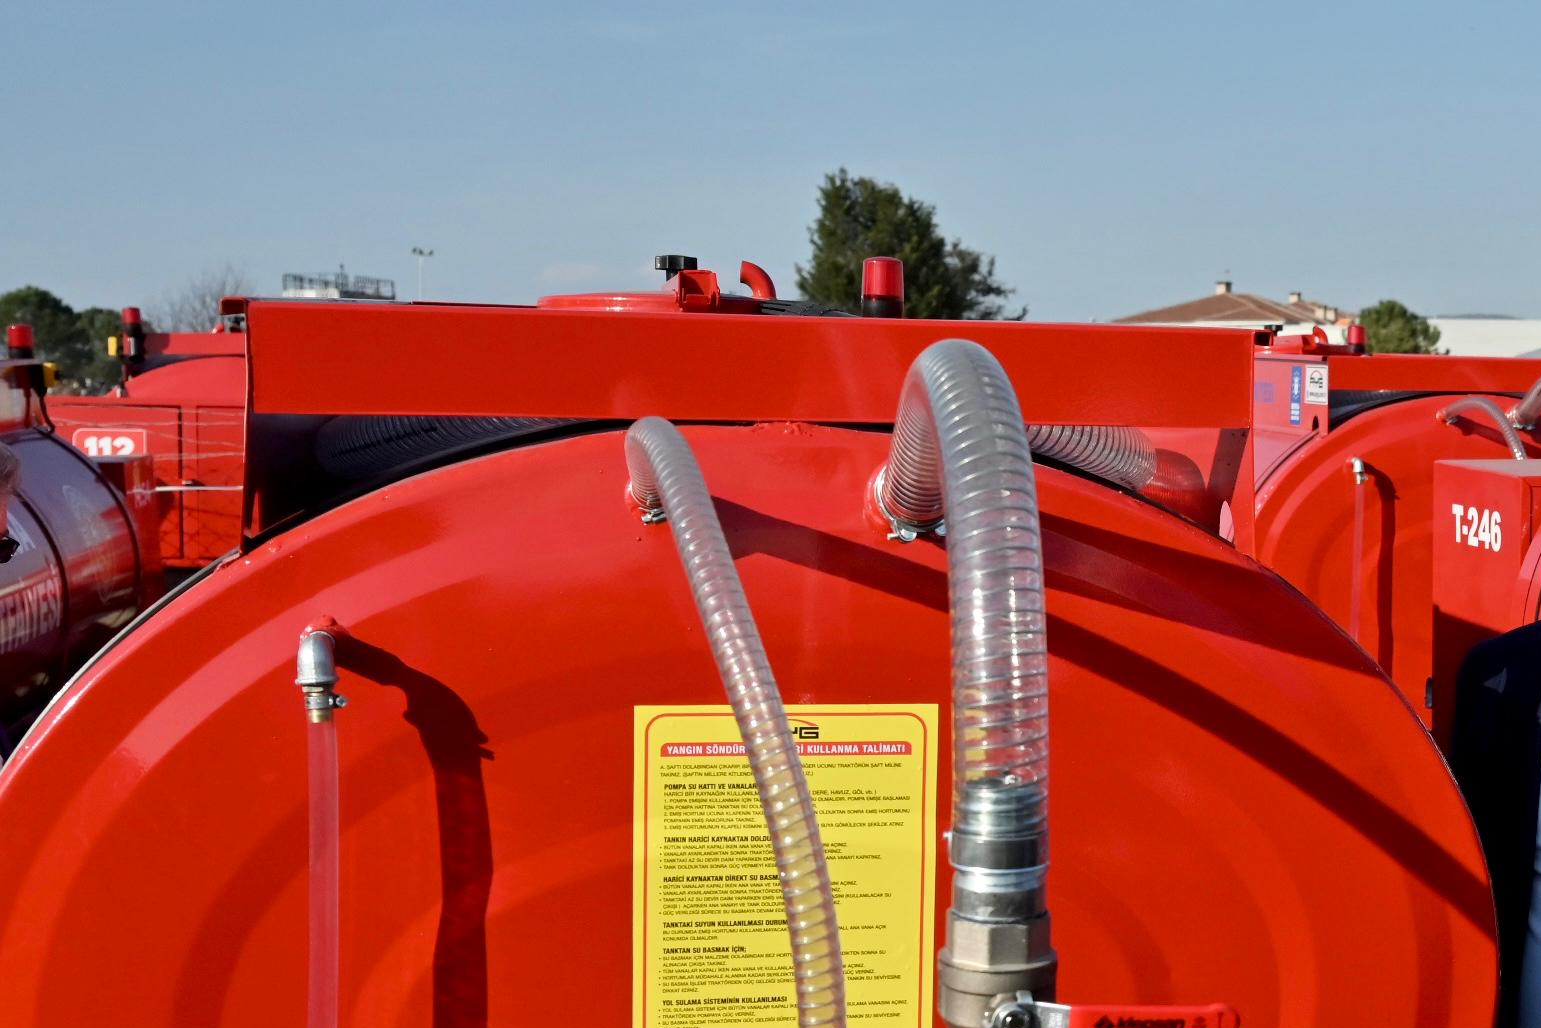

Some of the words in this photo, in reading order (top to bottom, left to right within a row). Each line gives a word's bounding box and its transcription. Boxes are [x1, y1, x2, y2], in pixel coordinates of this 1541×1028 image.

[84, 436, 135, 456] 112
[1452, 503, 1502, 553] T-246
[667, 745, 703, 755] YANGIN
[706, 743, 746, 754] SÖNDÜR
[807, 744, 859, 754] KULLANMA
[862, 742, 906, 753] TALİMATI
[688, 835, 710, 843] HARİCİ
[664, 875, 685, 883] HARİCİ
[725, 873, 747, 881] DİREKT
[663, 920, 693, 928] TANKTAKİ
[704, 997, 739, 1005] SİSTEMİNİN
[742, 996, 788, 1004] KULLANILMASI
